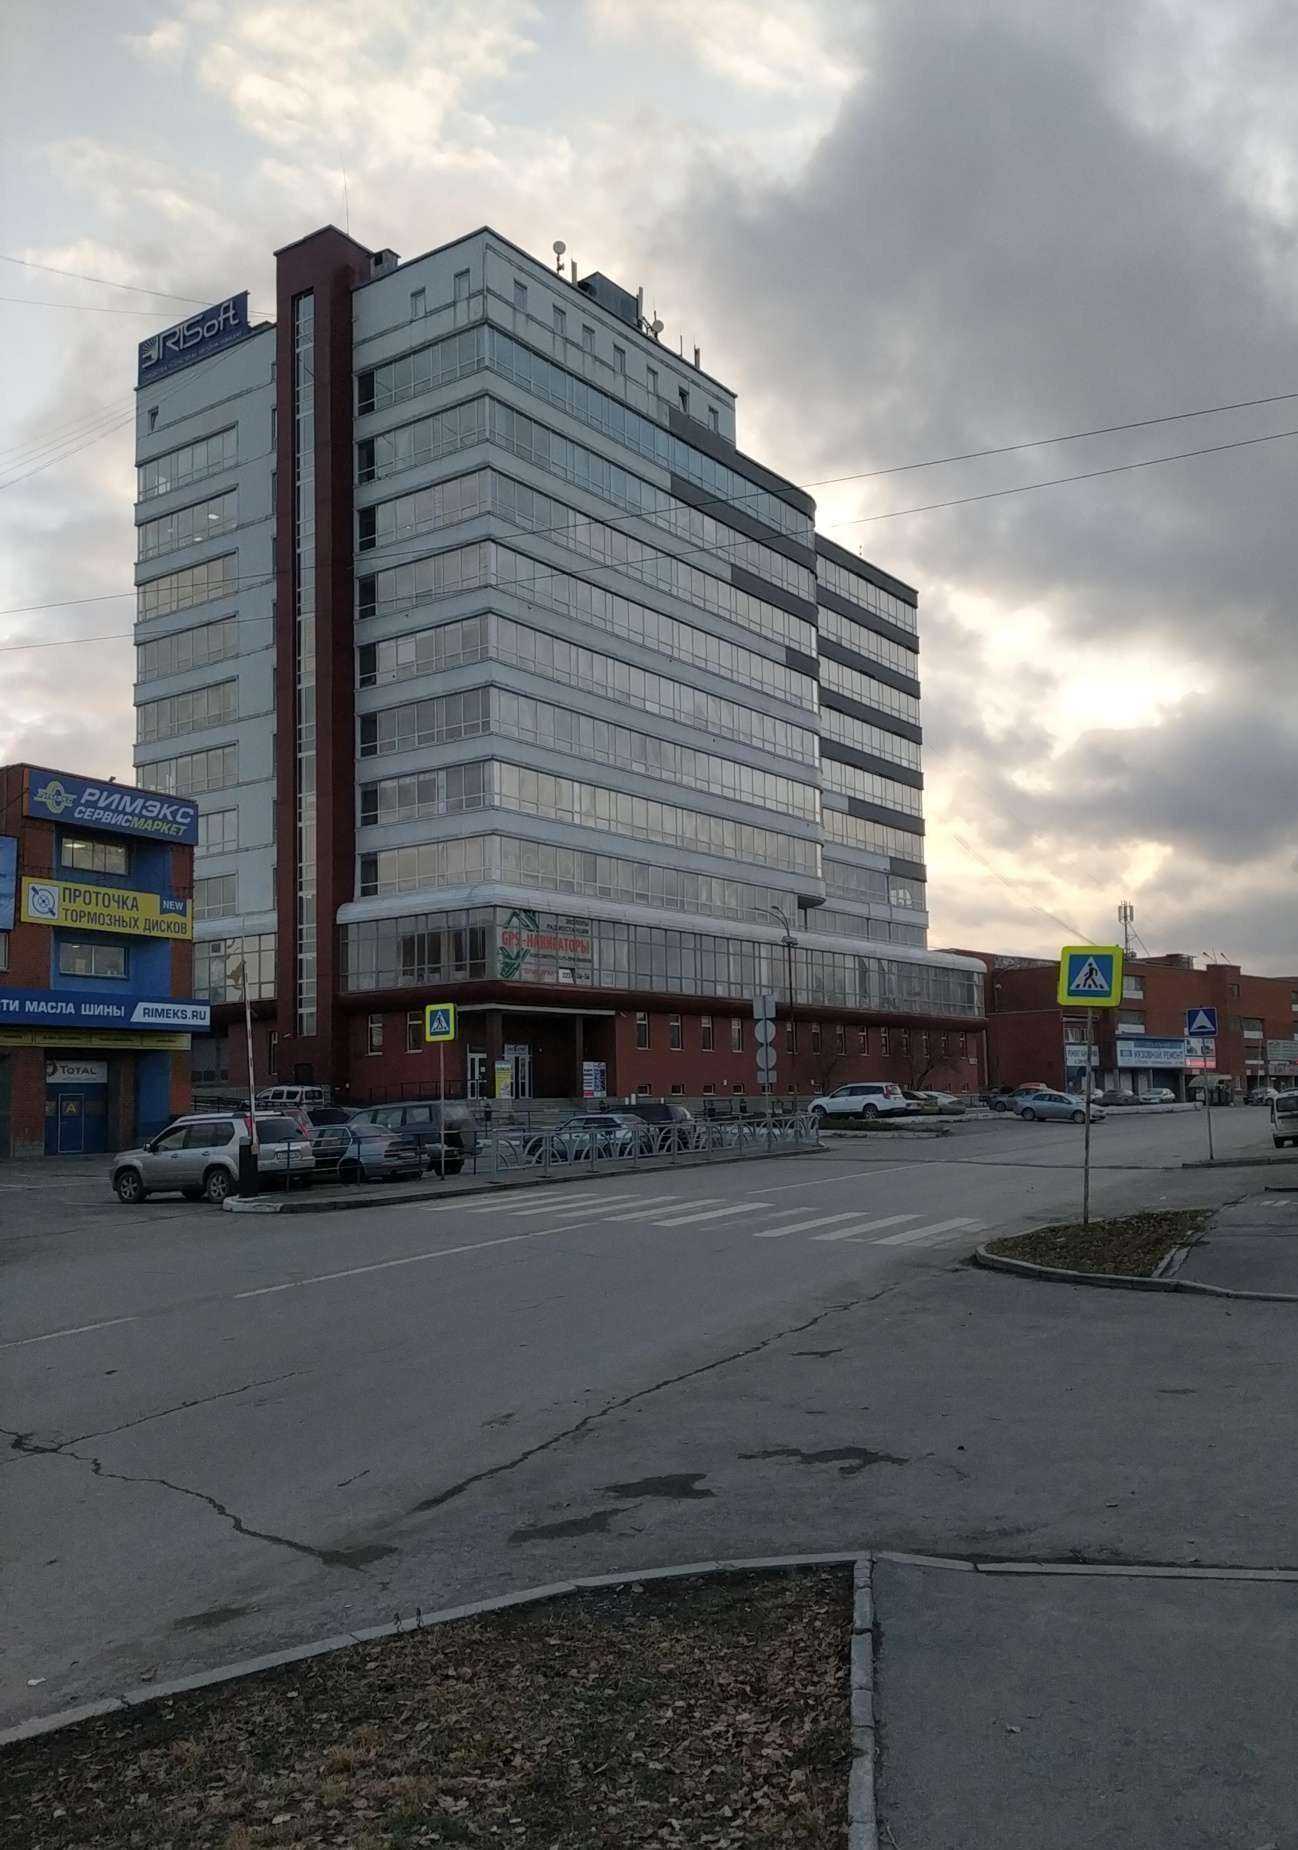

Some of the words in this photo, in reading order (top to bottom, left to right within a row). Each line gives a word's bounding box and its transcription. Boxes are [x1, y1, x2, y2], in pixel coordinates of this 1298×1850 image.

[80, 788, 194, 823] РИМЭКС
[74, 806, 187, 836] СЕРВИСМАРКЕТ
[62, 886, 139, 912] ПРОТОЧКА
[162, 899, 184, 911] NEW
[62, 908, 140, 929] ТОРМОЗНЫХ
[143, 918, 188, 935] ДИСКОВ
[0, 999, 19, 1012] ТИ
[25, 1000, 76, 1014] МАСЛА
[81, 1003, 125, 1017] ШИНЫ
[142, 1007, 207, 1020] RIMEKS.RU
